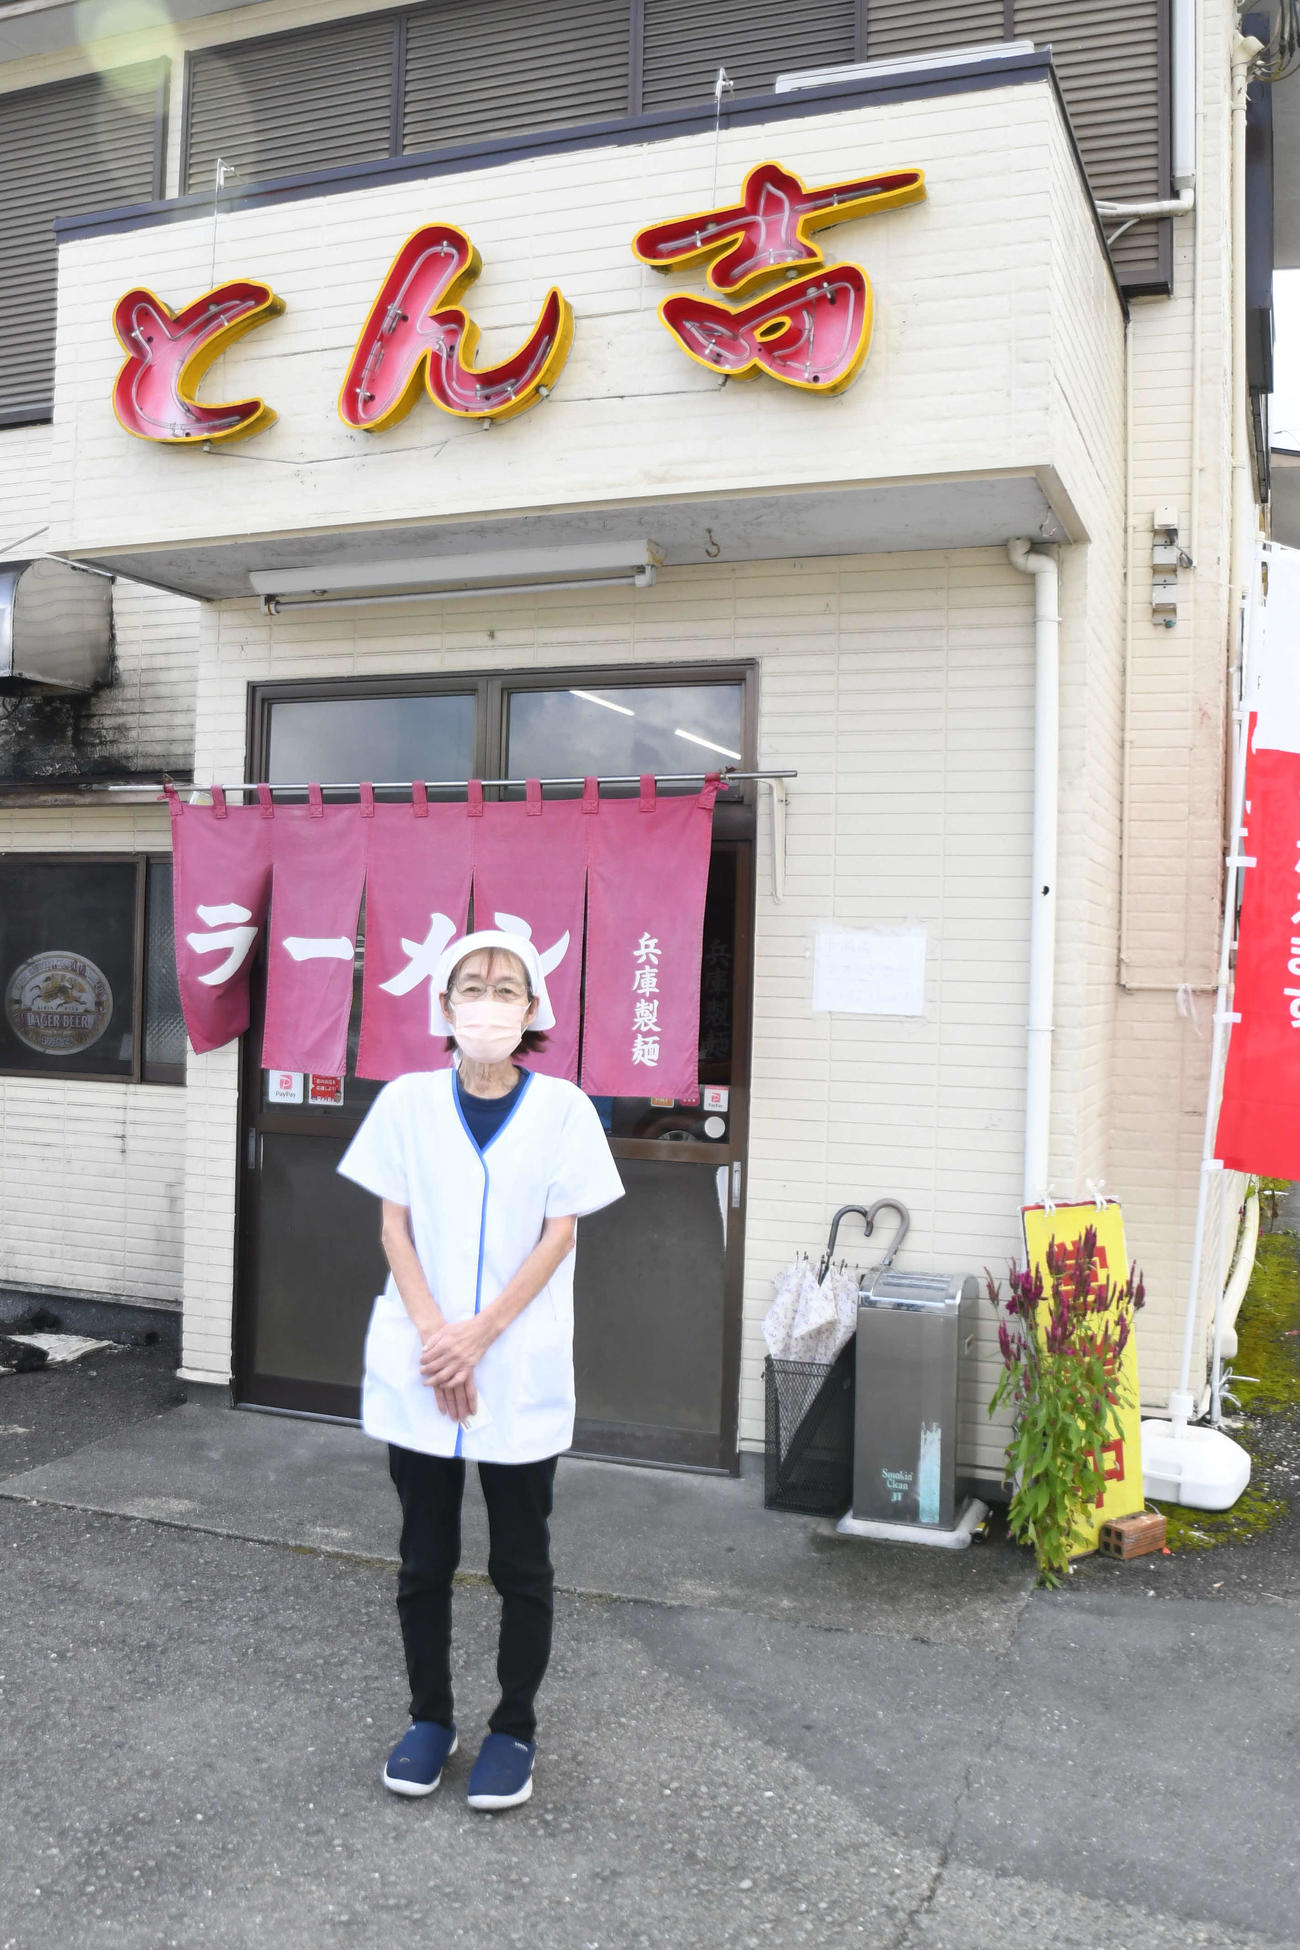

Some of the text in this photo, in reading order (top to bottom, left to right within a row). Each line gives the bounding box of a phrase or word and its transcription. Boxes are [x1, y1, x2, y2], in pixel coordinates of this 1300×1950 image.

[632, 931, 662, 1067] 兵庫製麺
[63, 1015, 89, 1028] BEER
[275, 1090, 296, 1098] PayPay
[886, 1479, 908, 1490] Clean
